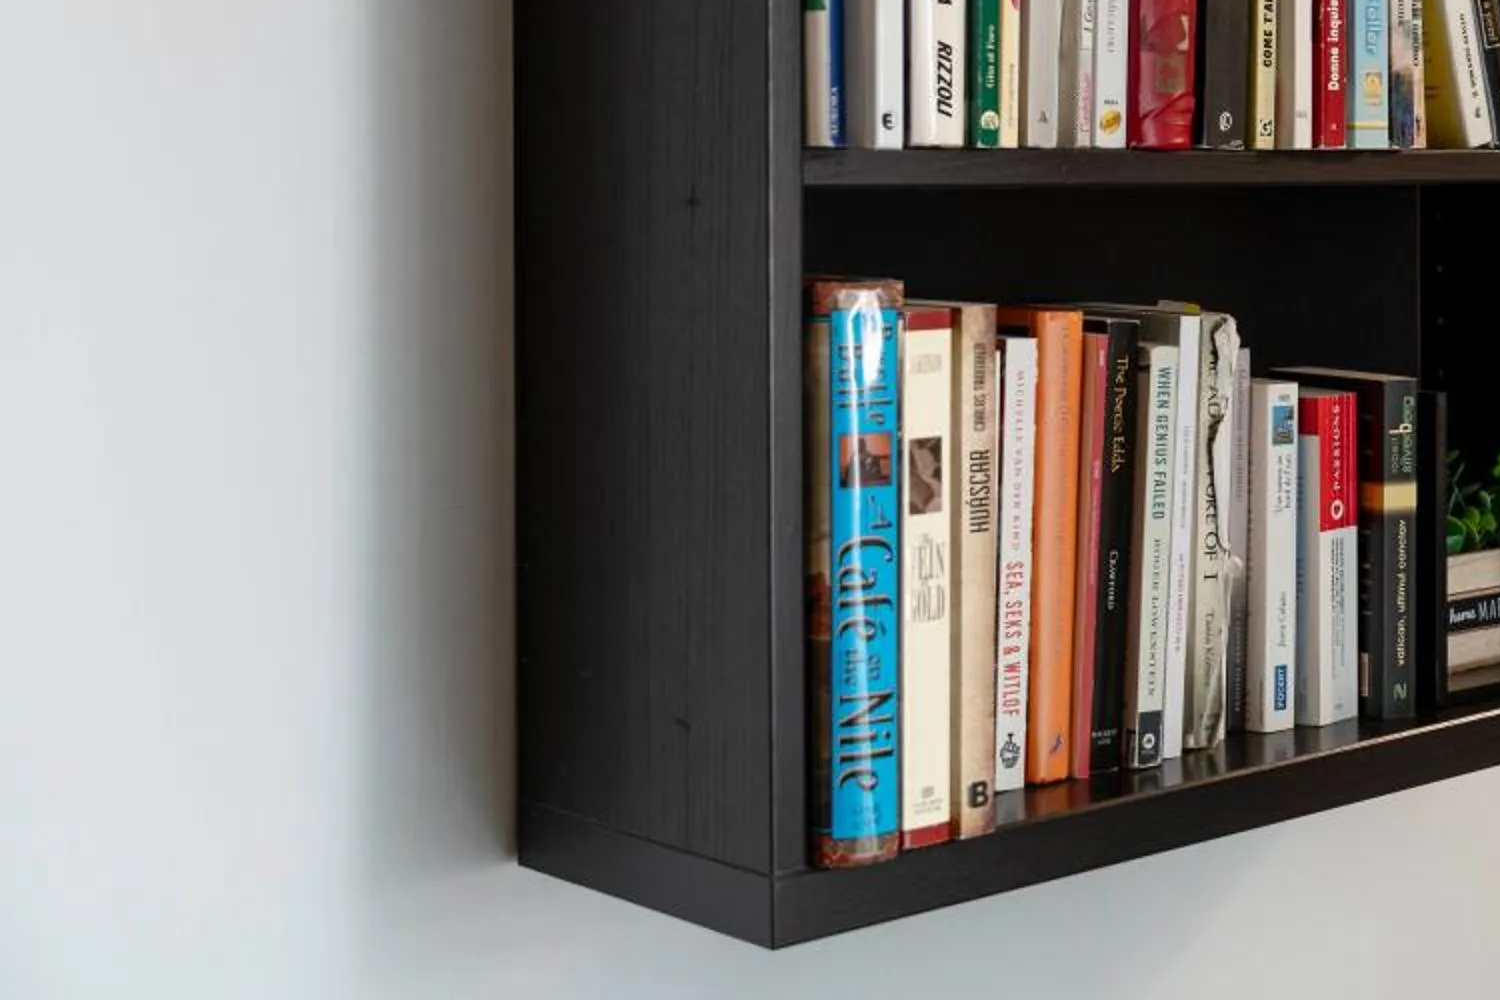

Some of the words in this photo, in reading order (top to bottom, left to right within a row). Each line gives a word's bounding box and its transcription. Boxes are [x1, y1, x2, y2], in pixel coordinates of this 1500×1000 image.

[1263, 29, 1274, 68] COME
[937, 40, 952, 118] RIZZOLI
[1114, 355, 1130, 383] The
[1156, 366, 1172, 409] WHEN
[1110, 436, 1126, 473] Edda
[1154, 415, 1169, 466] GENIUS
[966, 449, 991, 533] HUÁSCAR
[1152, 471, 1168, 520] FAILED
[837, 536, 894, 642] Café
[1004, 561, 1025, 595] SEA,
[1004, 599, 1023, 639] SEKS
[1003, 645, 1022, 656] &
[1002, 660, 1022, 716] WITLOF
[837, 689, 894, 791] Nile
